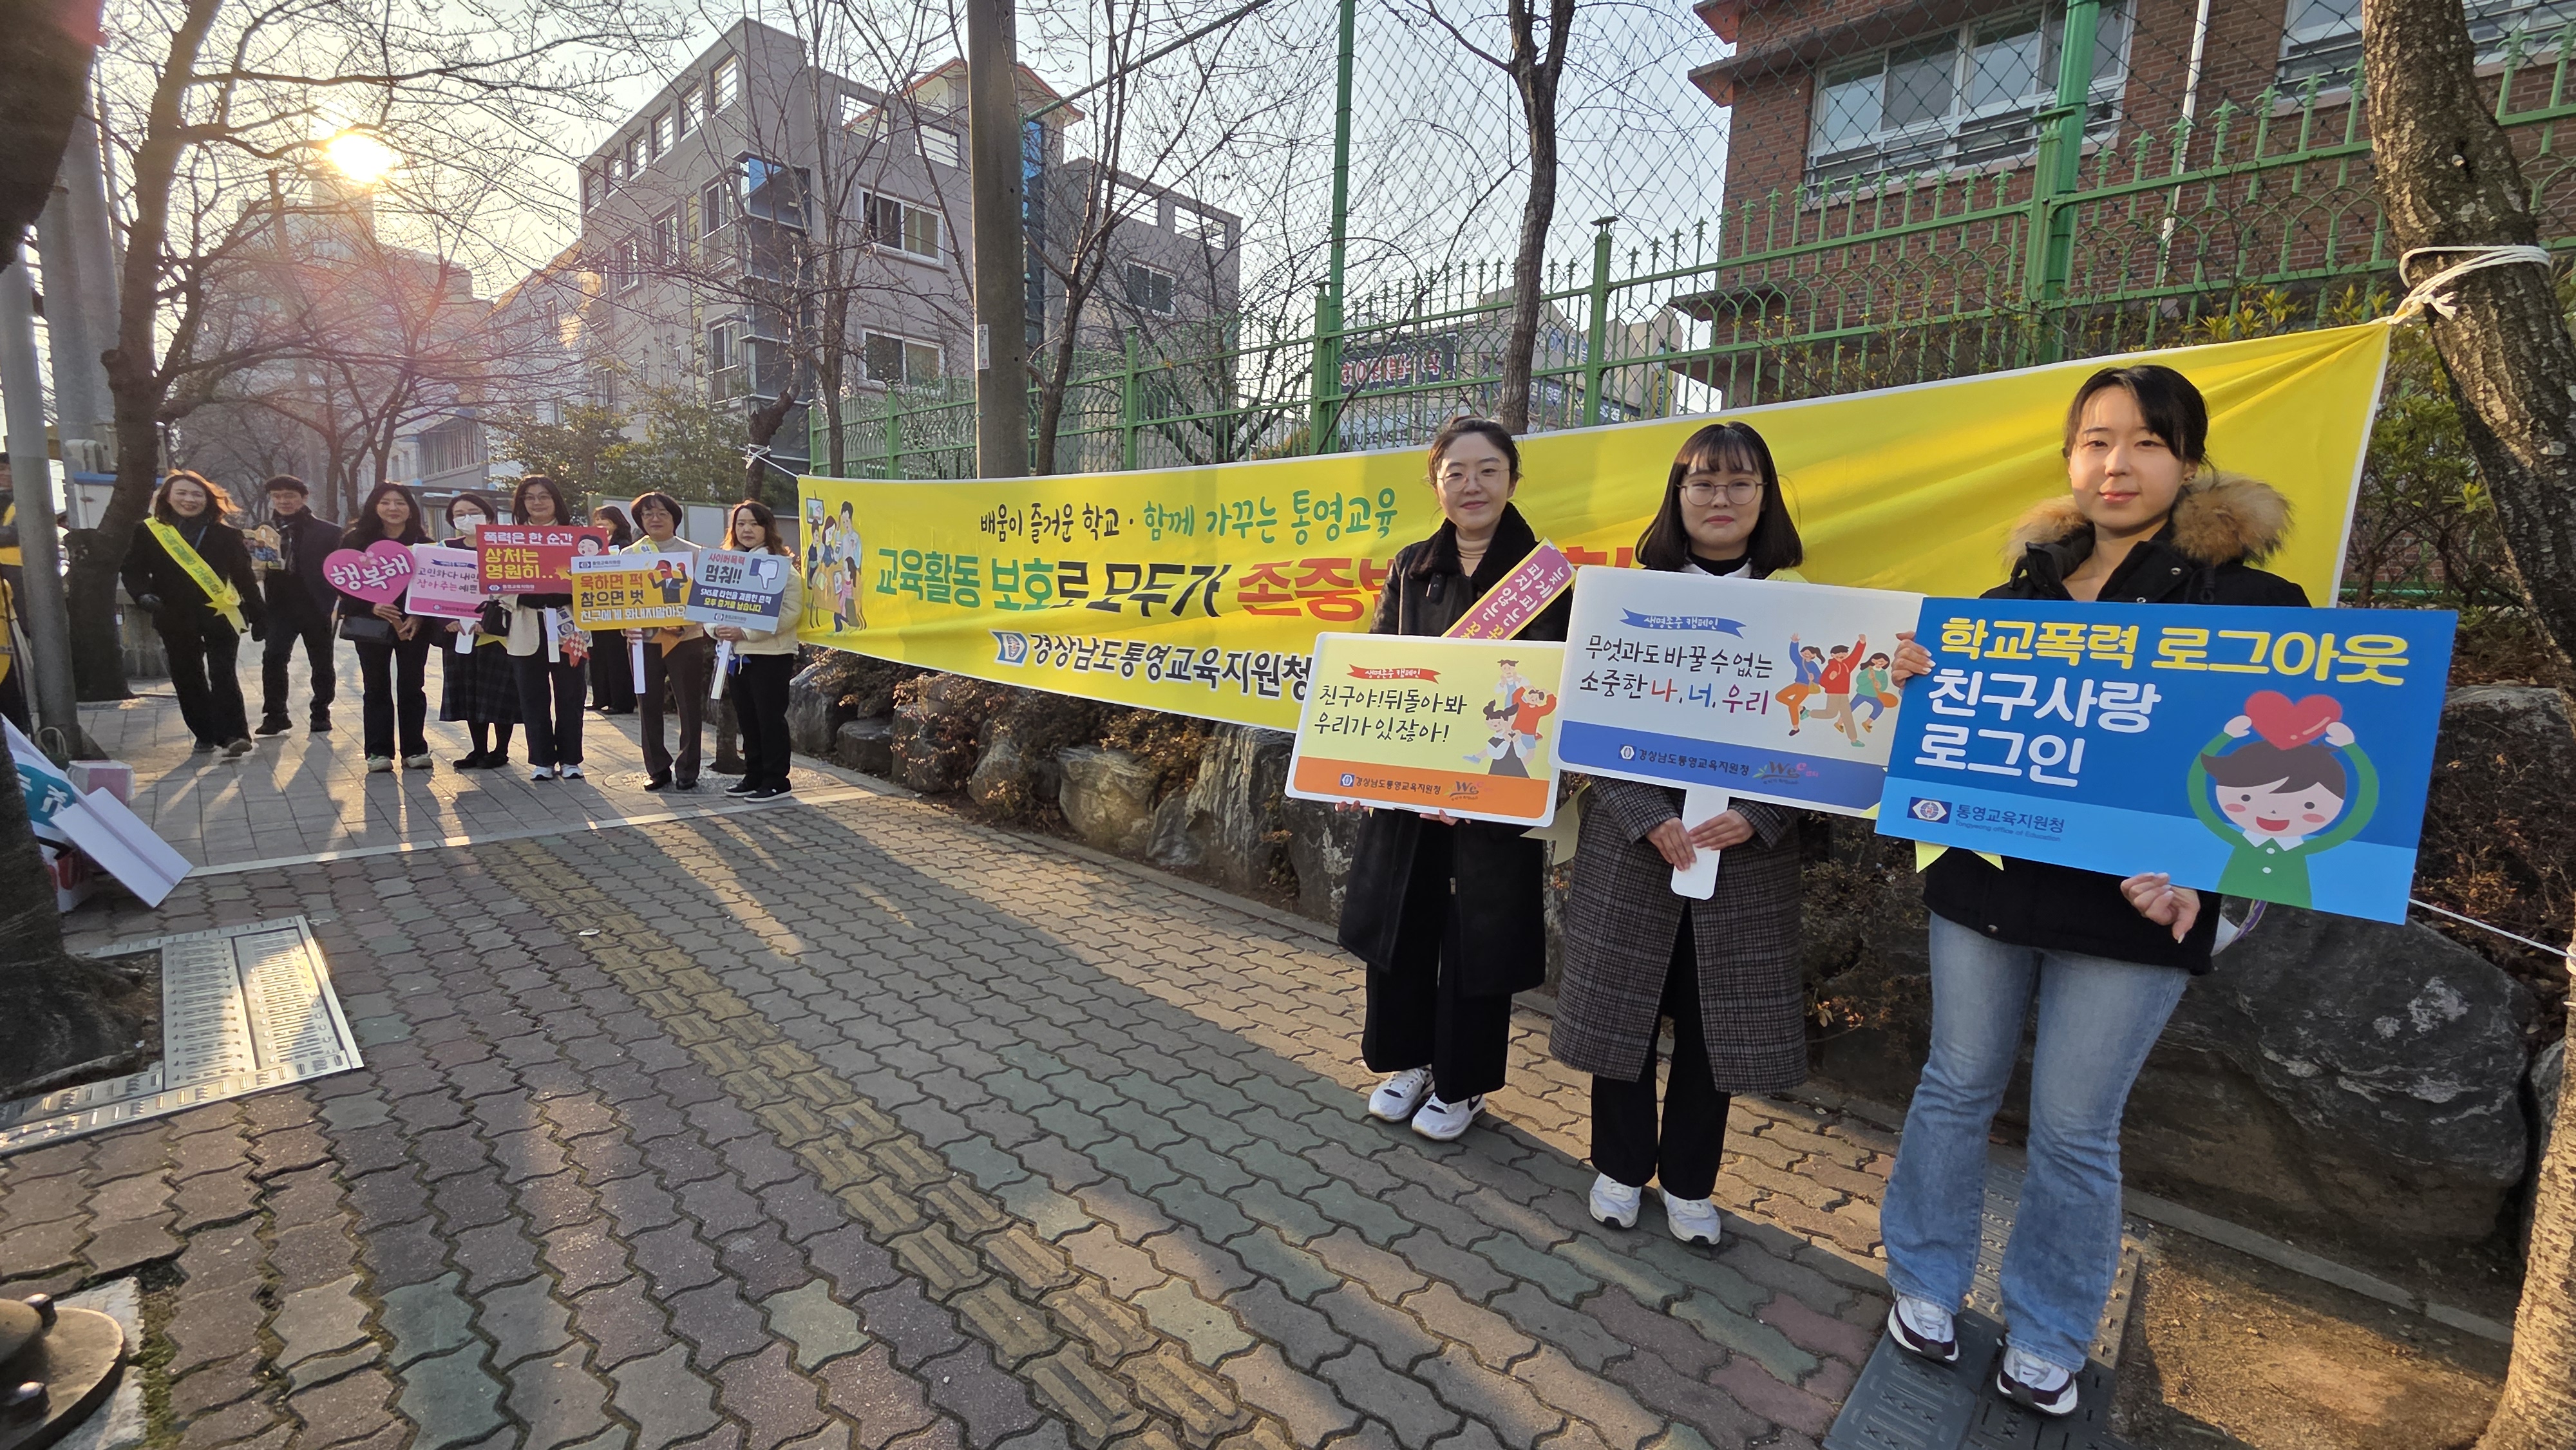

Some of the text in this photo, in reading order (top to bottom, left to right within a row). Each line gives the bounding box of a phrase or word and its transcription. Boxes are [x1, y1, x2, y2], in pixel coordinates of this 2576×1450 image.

[980, 504, 1023, 542] 배움이
[1030, 502, 1074, 544] 즐거운
[1082, 502, 1120, 541] 학교
[1143, 500, 1195, 541] 함께
[1206, 496, 1278, 544] 가꾸는
[1291, 487, 1398, 545] 통영교육
[484, 532, 573, 545] 폭력은 한 순간
[485, 548, 539, 563] 상처는
[708, 553, 746, 566] 사이버폭력
[330, 554, 410, 590] 행복해
[418, 567, 459, 579] 고민하다
[486, 564, 553, 579] 영원히..
[580, 573, 643, 590] 욱하면 퍽
[705, 565, 742, 584] 멈춰!!
[876, 549, 981, 608] 교육활동
[992, 558, 1088, 611] 보호로
[1085, 563, 1231, 617] 모두가
[1515, 563, 1544, 592] 피지
[1535, 567, 1564, 599] 늦게
[580, 590, 643, 607] 참으면 벗
[704, 598, 716, 607] 모두
[719, 590, 738, 600] 타인을
[1482, 587, 1517, 621] 않는
[580, 605, 687, 623] 친구에게 화내지말아요
[1503, 594, 1538, 627] 피는
[1643, 615, 1683, 629] 생명존중
[1586, 635, 1772, 678] 무엇과도 바꿀 수 없는
[1941, 617, 2409, 686] 학교폭력 로그아웃
[1030, 634, 1313, 701] 경상남도통영교육지원청
[1365, 668, 1394, 679] 생명존중
[1580, 669, 1648, 699] 소중한
[1722, 684, 1768, 715] 우리
[1929, 668, 2161, 733] 친구사랑
[1314, 711, 1372, 736] 우리가
[1639, 749, 1749, 777] 경상남도통영교육지원청
[1914, 722, 2085, 787] 로그인
[1356, 777, 1441, 795] 경상남도통영교육지원청
[1955, 819, 1992, 833] Tongyeong
[1993, 827, 2014, 835] office
[2025, 831, 2061, 842] Education
[1956, 804, 2065, 833] 통영교육지원청
